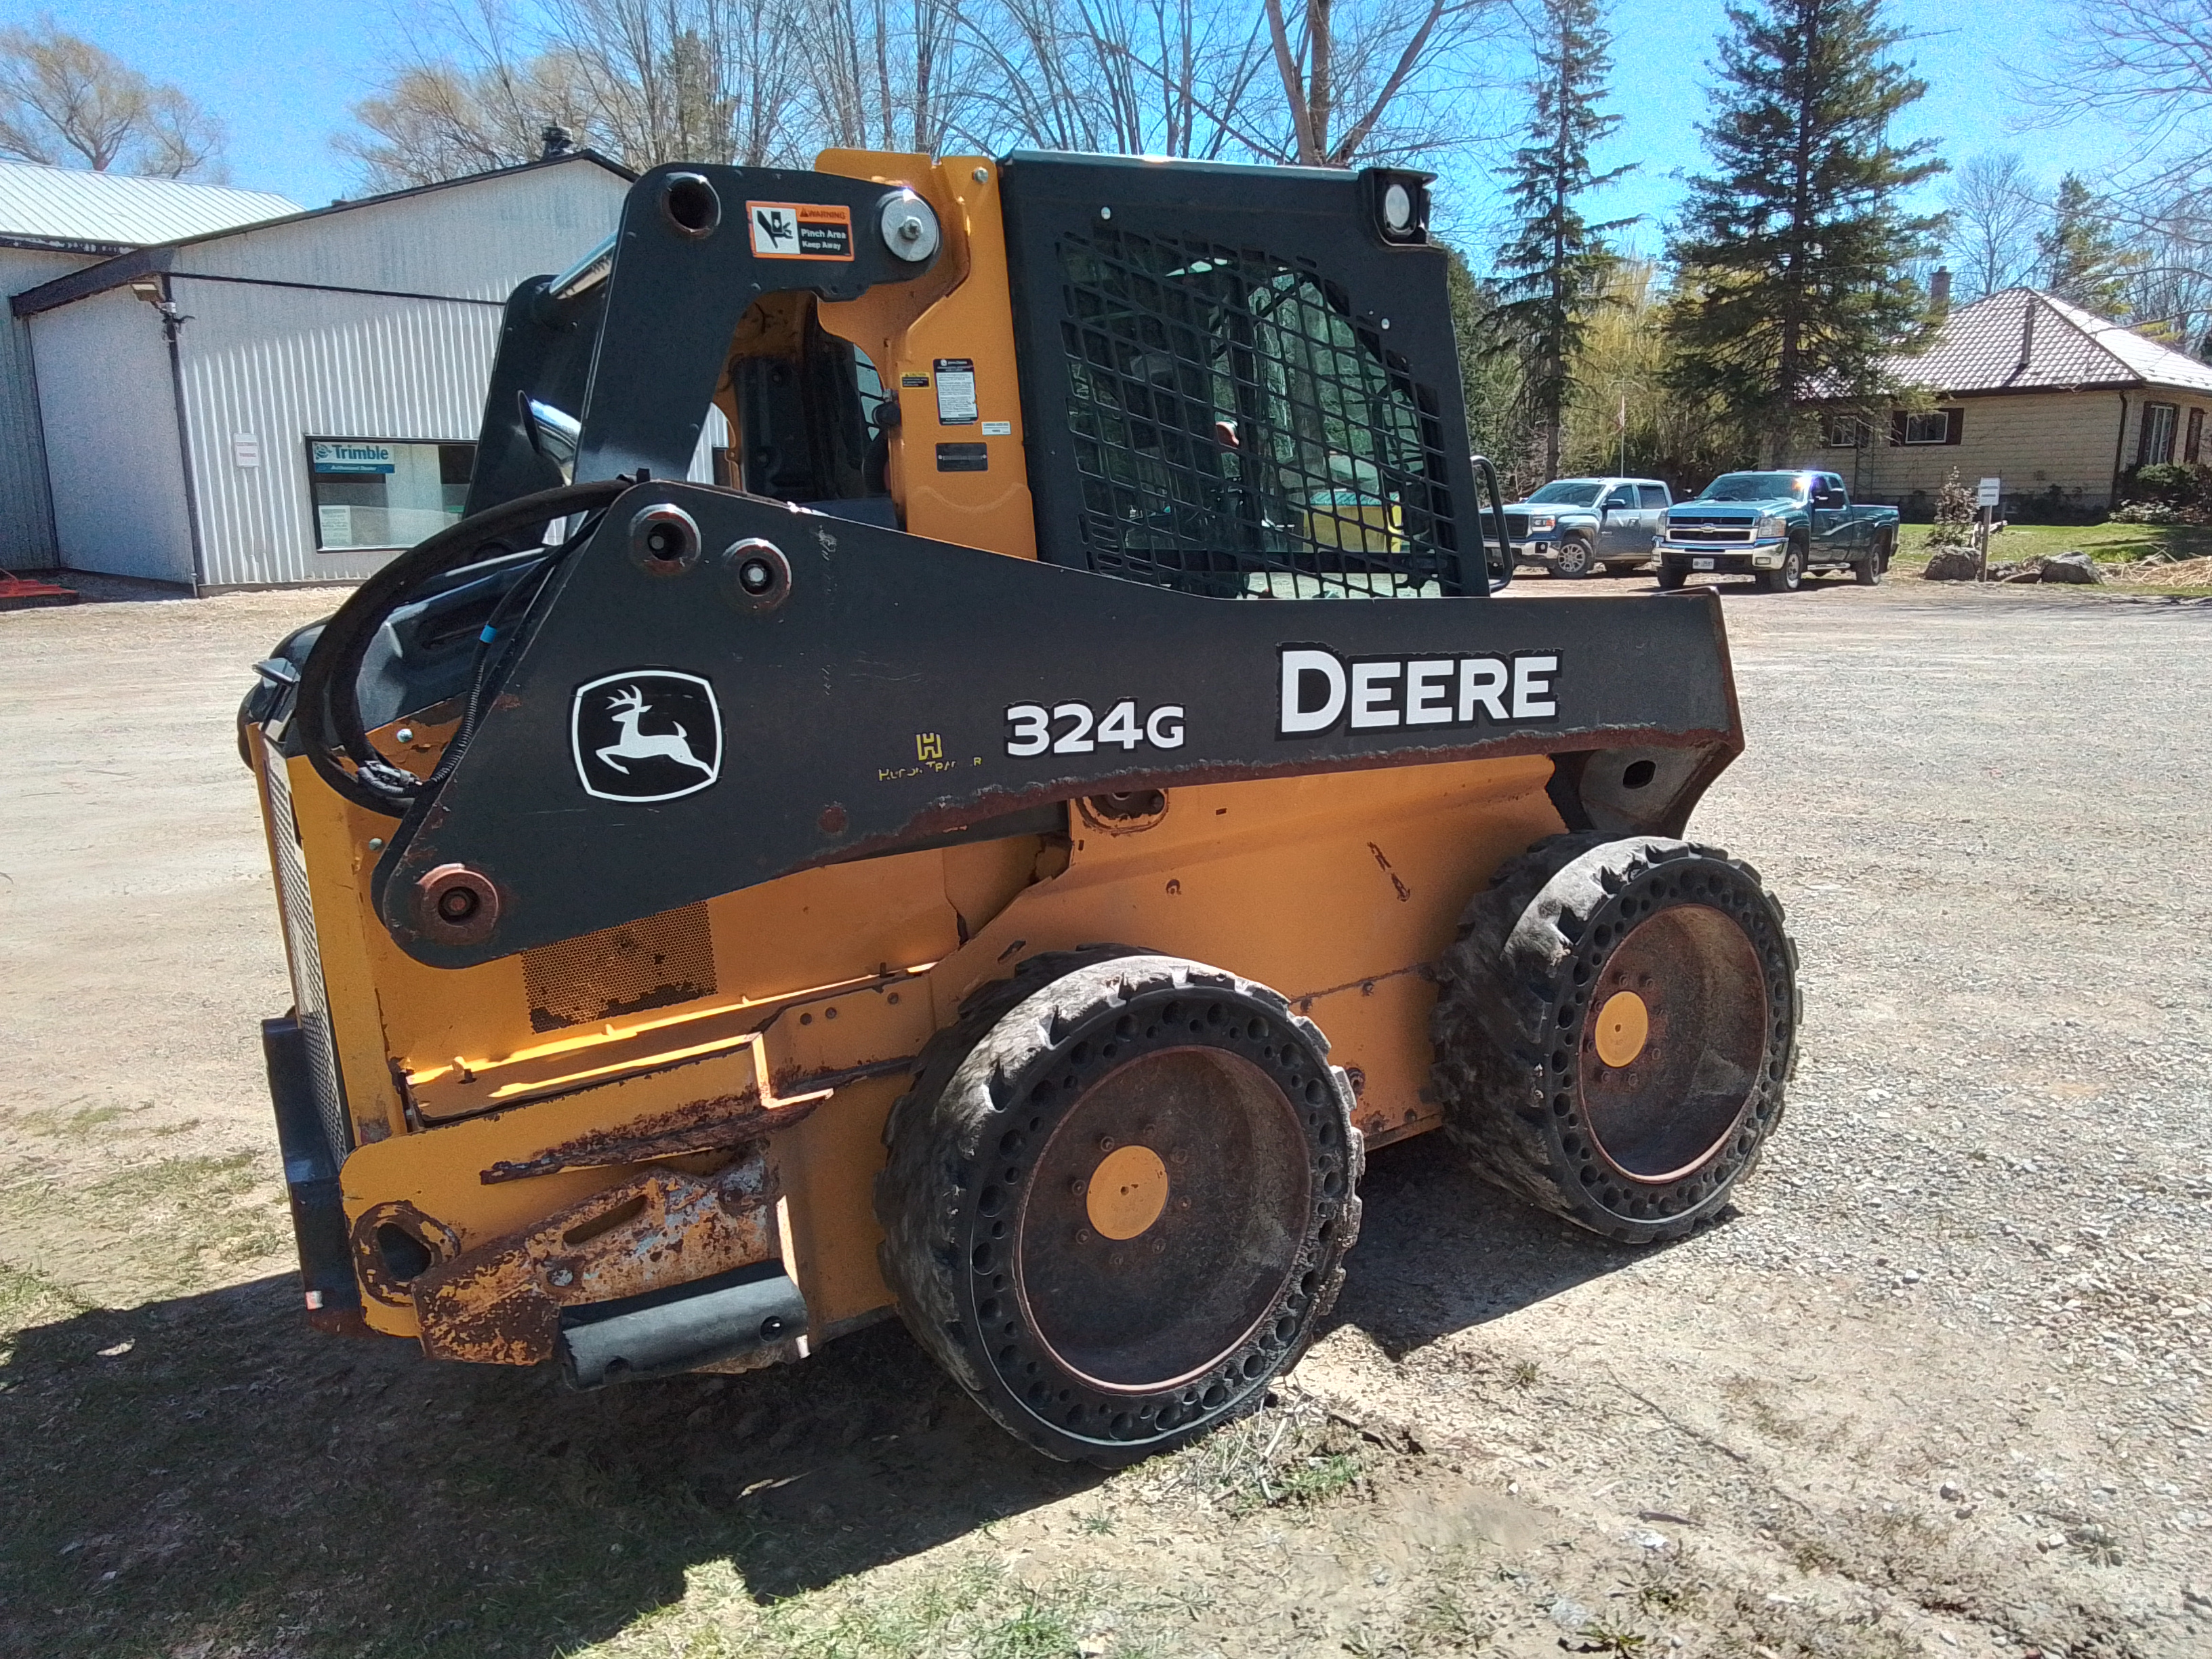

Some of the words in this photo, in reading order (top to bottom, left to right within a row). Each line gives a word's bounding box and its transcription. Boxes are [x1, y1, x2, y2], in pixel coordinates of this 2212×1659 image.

[808, 210, 846, 220] WARNING
[800, 228, 825, 238] Pinch
[827, 229, 847, 239] Area
[802, 241, 821, 250] Keep
[822, 241, 842, 251] Away
[331, 444, 389, 460] Trimble
[1281, 650, 1557, 733] DEERE
[1007, 701, 1184, 756] 324G
